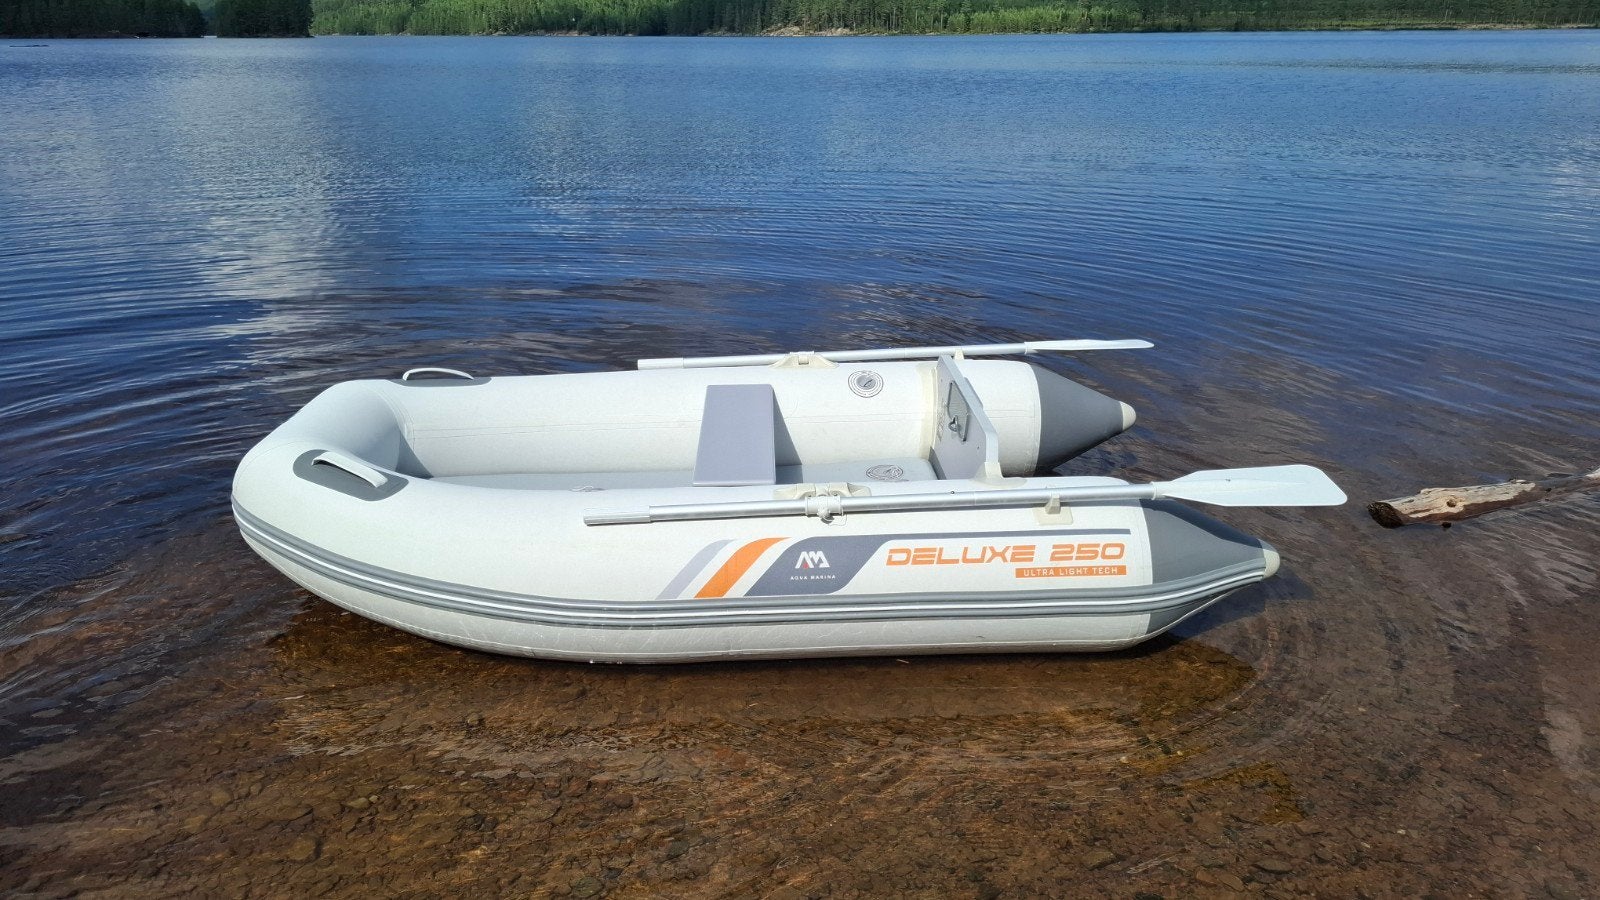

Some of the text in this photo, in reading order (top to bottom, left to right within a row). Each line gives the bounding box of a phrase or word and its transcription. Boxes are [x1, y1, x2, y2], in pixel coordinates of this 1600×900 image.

[885, 542, 1126, 566] DELUXE 250
[1023, 566, 1118, 577] ULTRA LIGHT TECH
